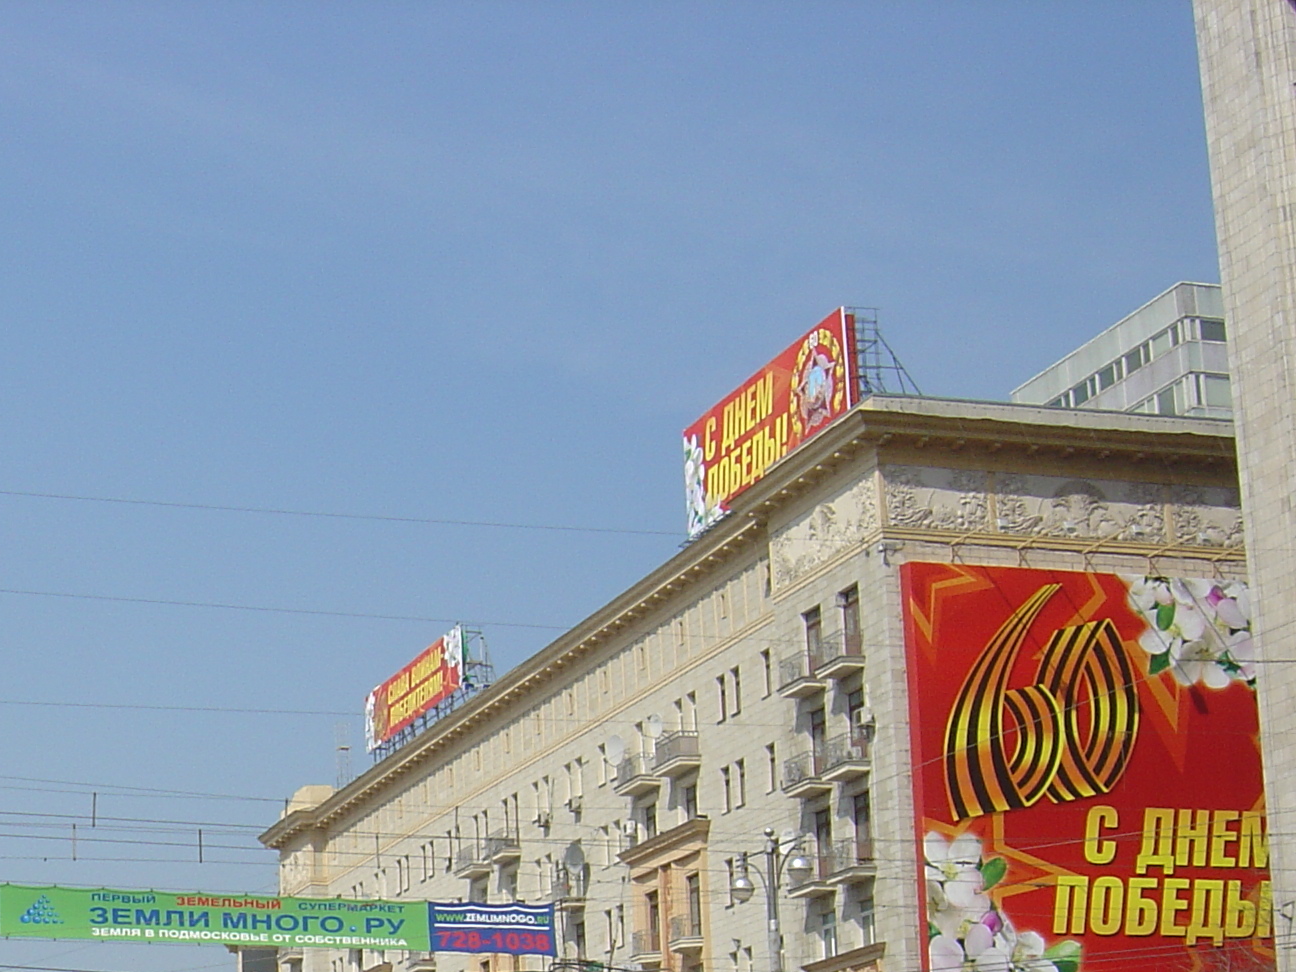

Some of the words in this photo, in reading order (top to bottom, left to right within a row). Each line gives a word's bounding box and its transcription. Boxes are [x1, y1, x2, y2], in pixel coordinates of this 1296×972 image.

[705, 416, 717, 462] С
[721, 370, 774, 456] ДНЕМ
[705, 411, 788, 510] ПОБЕДЫ!
[1083, 805, 1119, 866] С
[90, 892, 156, 905] ПЕРВЫЙ
[175, 896, 282, 910] ЗЕМЕЛЬНЫЙ
[297, 901, 406, 914] СУПЕРМАРКЕТ
[89, 906, 210, 928] ЗЕМЛИ
[435, 913, 549, 925] WWW.ZEMLIMNOGO.RU
[91, 927, 141, 938] ЗЕМЛЯ
[145, 929, 155, 938] В
[158, 929, 269, 943] ПОДМОСКОВЬЕ
[272, 933, 292, 943] ОТ
[294, 935, 408, 948] СОБСТВЕННИКА
[437, 930, 551, 951] 728-1038
